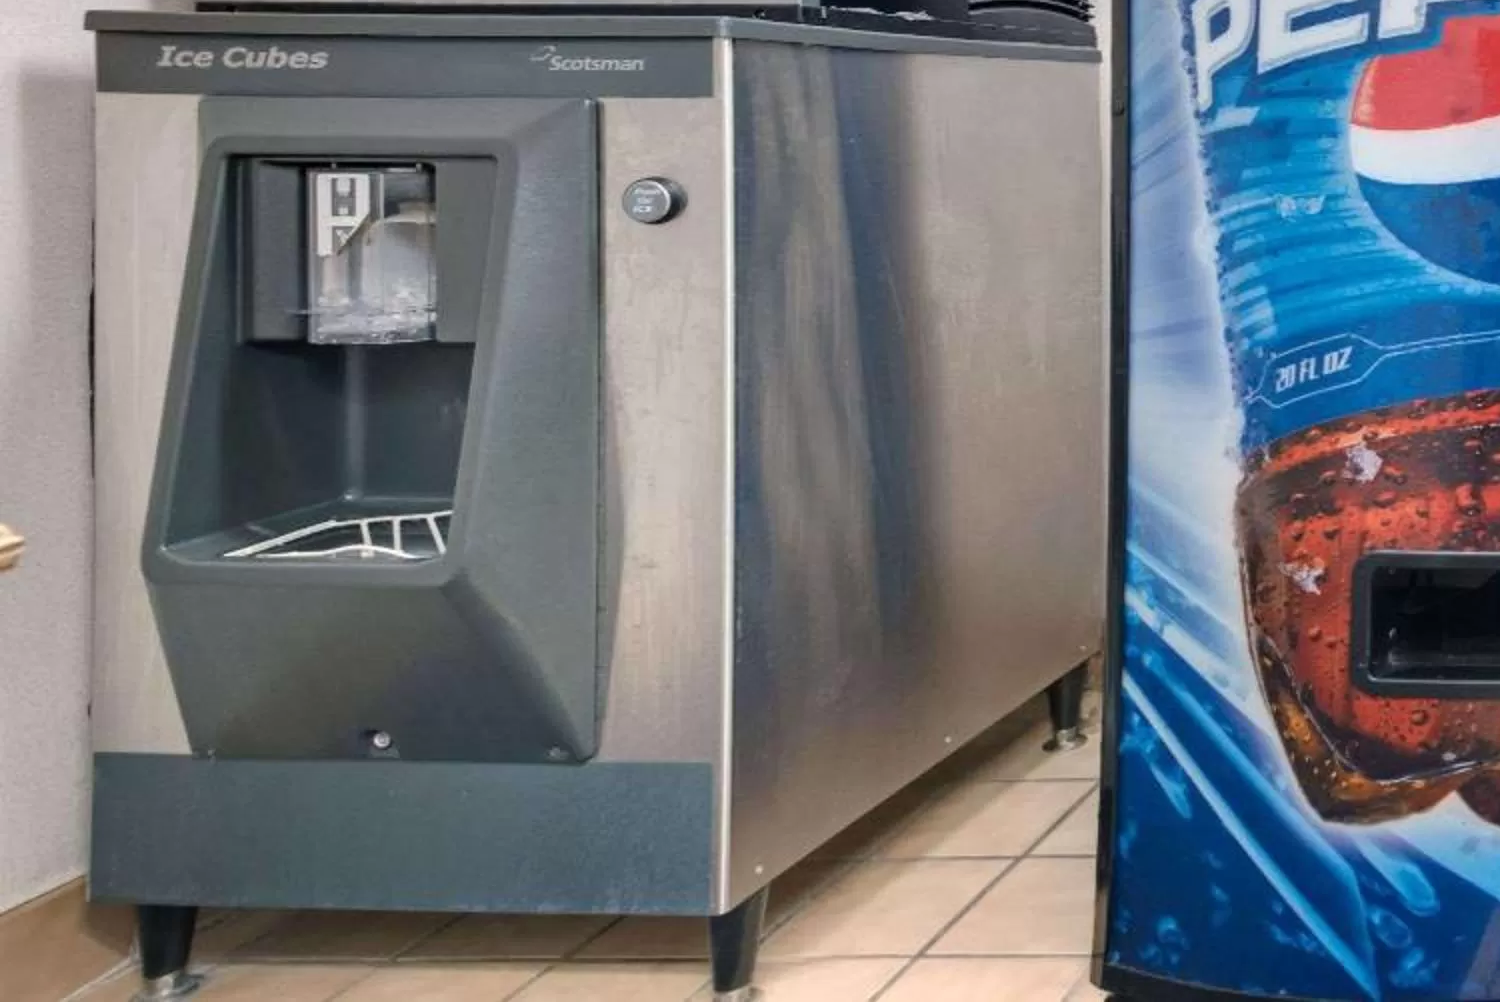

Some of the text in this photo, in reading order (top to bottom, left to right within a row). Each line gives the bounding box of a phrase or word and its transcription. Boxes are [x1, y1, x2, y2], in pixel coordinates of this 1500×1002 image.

[156, 45, 330, 70] Ice Cubes
[548, 55, 646, 71] Scotsman
[1276, 345, 1353, 393] 20 FL OZ
